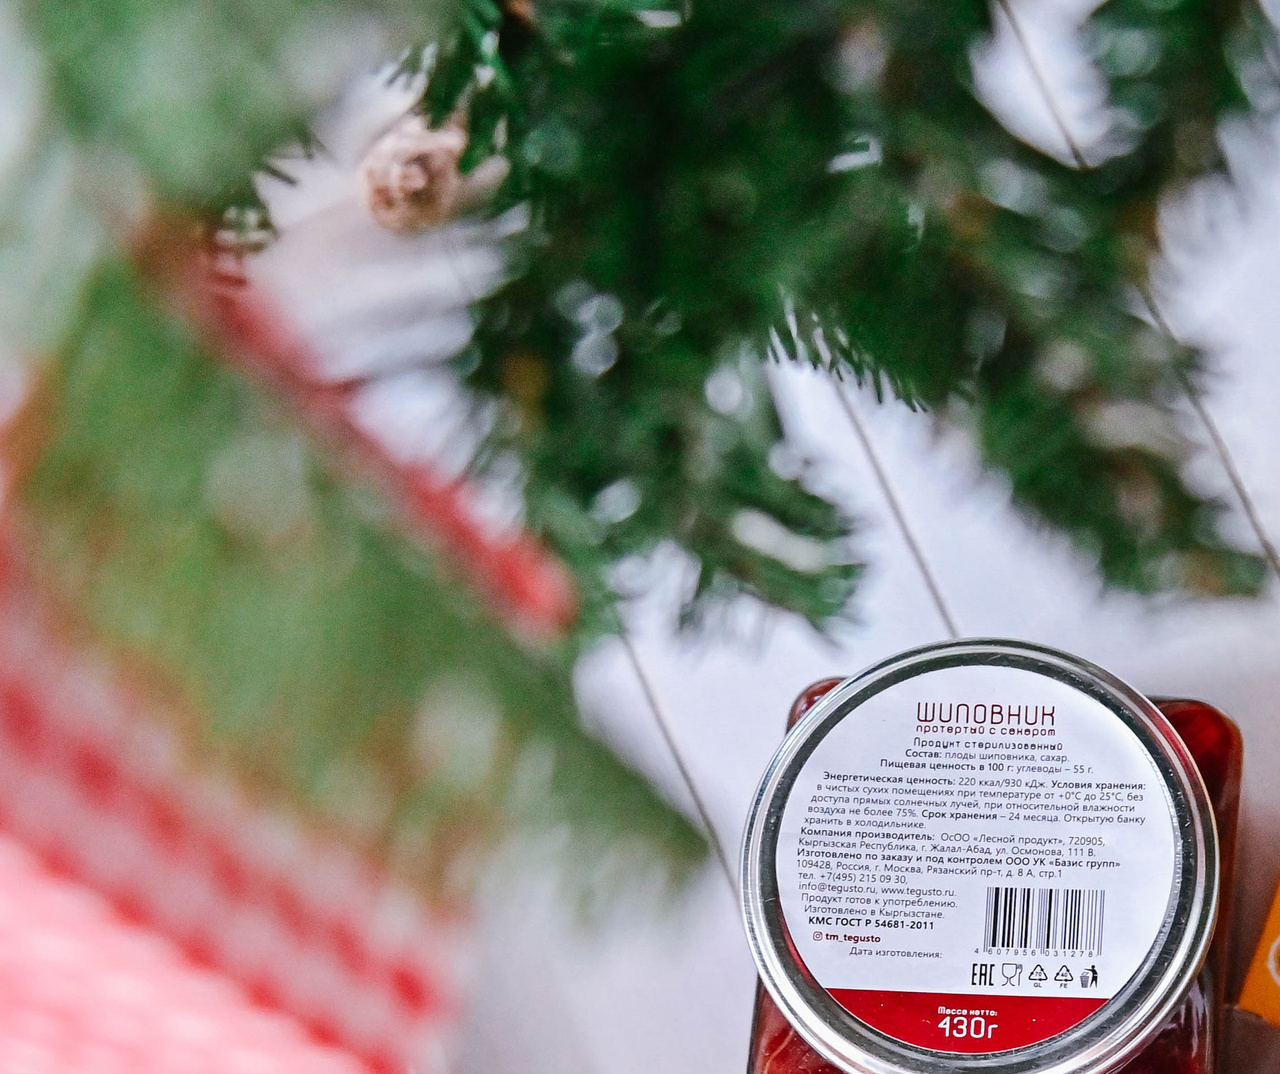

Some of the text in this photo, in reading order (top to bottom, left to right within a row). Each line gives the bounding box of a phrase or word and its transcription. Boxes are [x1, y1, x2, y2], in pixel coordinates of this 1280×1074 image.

[916, 702, 1056, 726] ШИПОВНИК
[916, 723, 1055, 737] протертый сахаром
[913, 738, 1062, 752] Продукт стерилизованный
[944, 752, 976, 761] плоды
[880, 759, 926, 770] Пищевая
[929, 763, 975, 772] ценность
[988, 762, 1004, 771] 100
[1016, 765, 1061, 774] углеводы
[1073, 764, 1084, 773] 55
[823, 773, 903, 785] Энергетическая
[958, 776, 976, 785] 220
[979, 777, 1022, 788] ккал/930
[1051, 779, 1092, 788] Условия
[862, 787, 888, 796] сухих
[891, 788, 954, 797] помещениях
[957, 790, 975, 798] при
[979, 790, 1041, 800] температуре
[1083, 793, 1096, 801] до
[1126, 792, 1143, 801] без
[810, 797, 849, 806] доступа
[853, 798, 890, 807] прямых
[984, 802, 1002, 810] при
[1005, 800, 1079, 810] относительной
[1082, 804, 1134, 812] влажности
[804, 819, 843, 827] хранить
[807, 807, 845, 816] воздуха
[863, 807, 893, 816] более
[921, 809, 946, 819] Срок
[949, 812, 997, 821] хранения
[1008, 811, 1019, 820] 24
[1063, 813, 1114, 825] Открытую
[1116, 815, 1145, 826] банку
[800, 827, 851, 837] Компания
[940, 832, 970, 841] ОсОО
[973, 833, 1015, 842] «Лесной
[798, 838, 856, 850] Кыргызская
[797, 849, 862, 859] Изготовлено
[880, 854, 913, 863] заказу
[925, 855, 944, 864] под
[947, 856, 1002, 865] контролем
[1005, 856, 1030, 865] ООО
[1032, 857, 1046, 865] УК
[1048, 857, 1083, 866] «Базис
[1086, 858, 1120, 869] групп»
[926, 864, 976, 874] Рязанский
[820, 871, 856, 883] +7(495)
[859, 873, 876, 881] 215
[879, 874, 891, 882] 09
[801, 893, 842, 904] Продукт
[804, 904, 867, 915] Изготовлено
[808, 915, 832, 924] КМС
[835, 916, 862, 925] ГОСТ
[874, 918, 934, 929] 54681-2011
[825, 932, 880, 943] tm_tegusto
[849, 947, 872, 957] Дата
[938, 1006, 968, 1016] Масса
[938, 1016, 998, 1038] 430г
